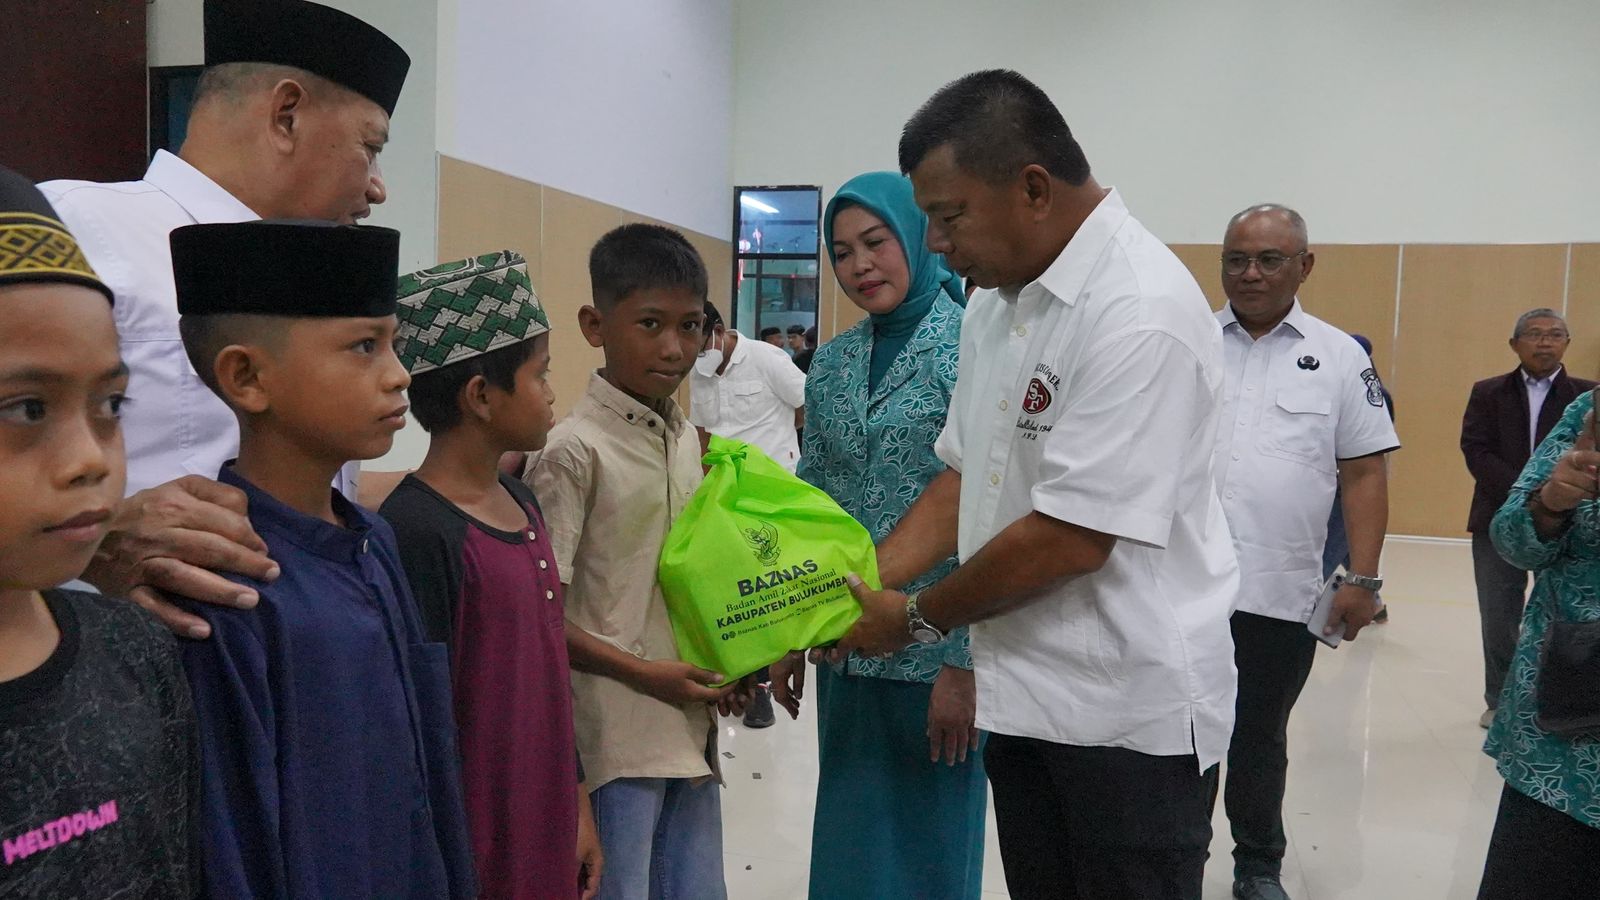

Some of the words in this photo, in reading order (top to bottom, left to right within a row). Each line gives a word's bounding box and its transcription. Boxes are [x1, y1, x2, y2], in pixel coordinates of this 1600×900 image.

[726, 599, 756, 612] Badan
[758, 589, 779, 602] Amil
[801, 568, 837, 587] Nasional
[737, 559, 818, 597] BAZNAS
[717, 599, 787, 629] KABUPATEN
[788, 576, 848, 605] BULUKUMBA
[2, 799, 118, 865] MELTDOWN
